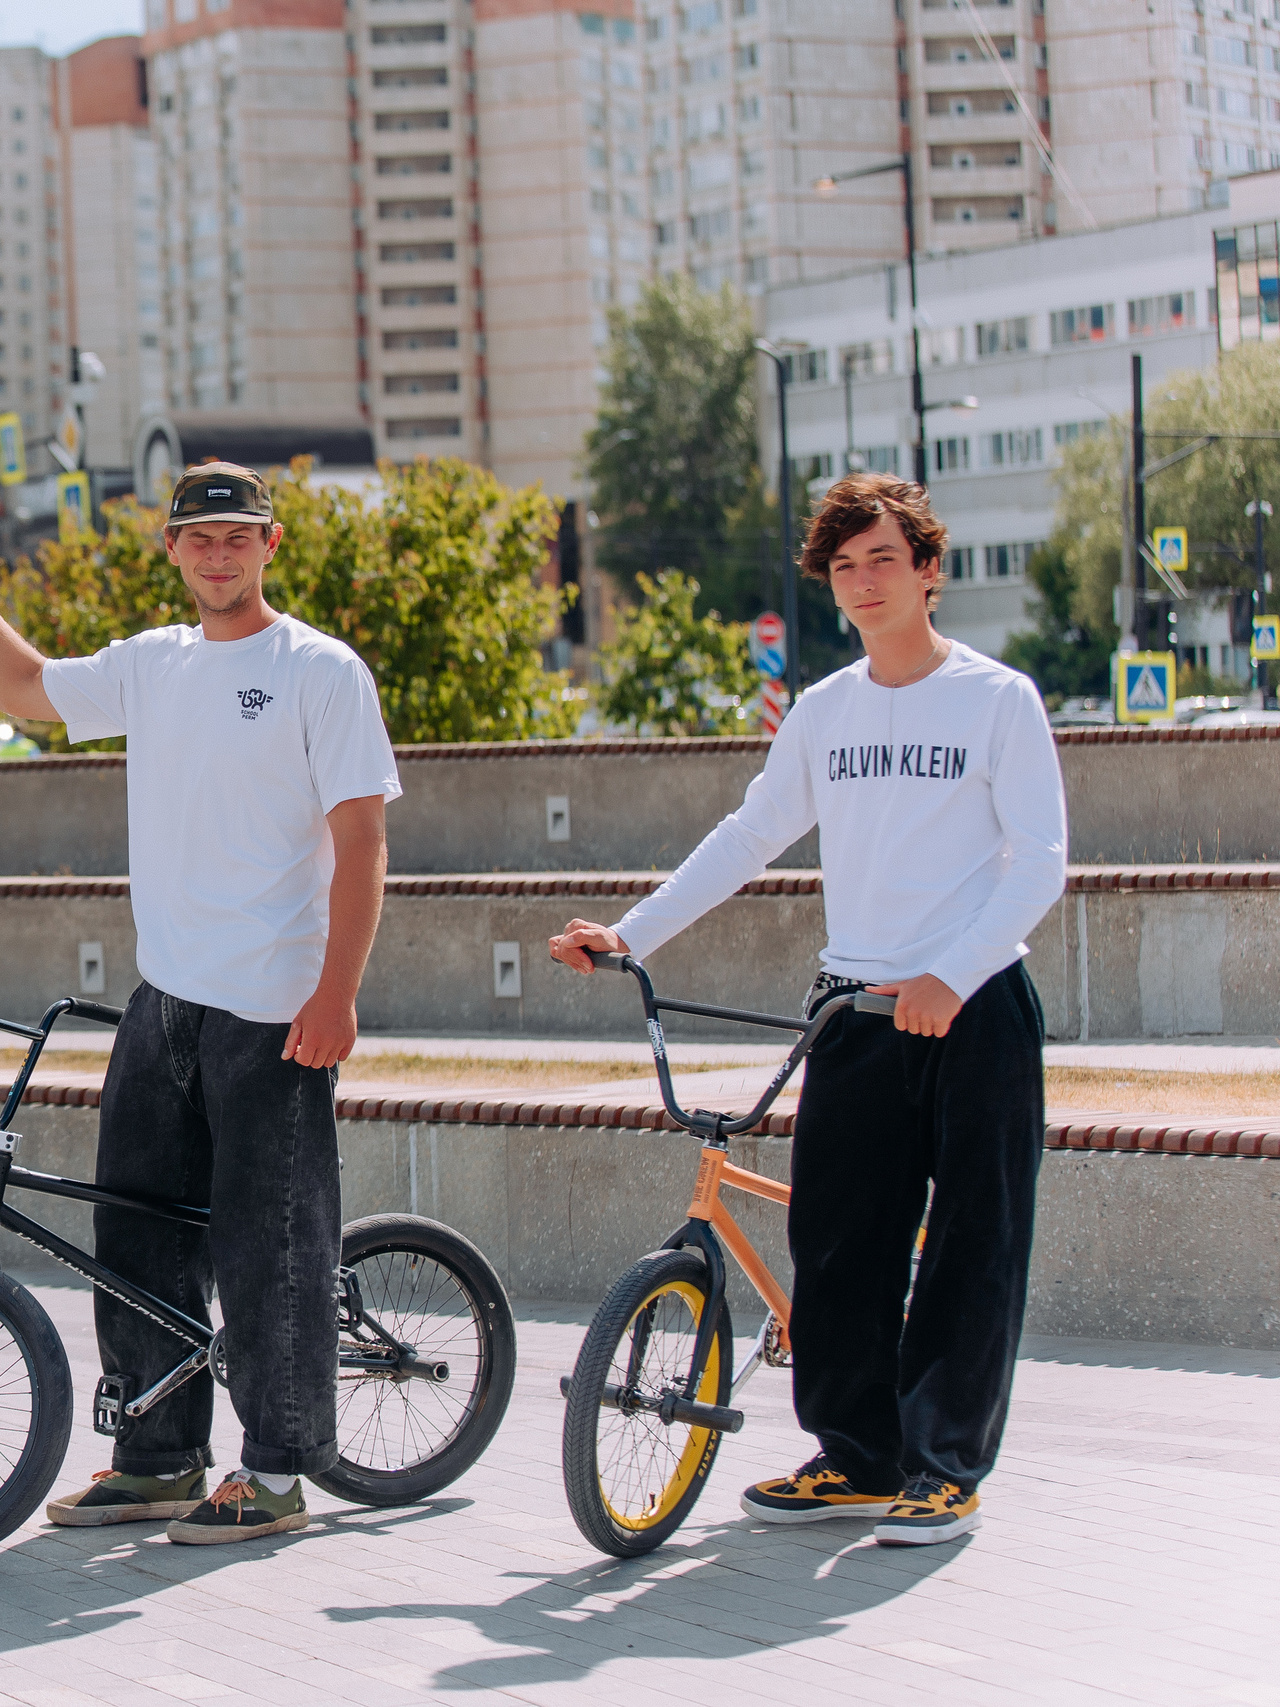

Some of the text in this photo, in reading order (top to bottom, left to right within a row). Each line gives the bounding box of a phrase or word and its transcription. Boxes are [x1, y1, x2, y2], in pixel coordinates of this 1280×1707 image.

[828, 744, 967, 782] CALVIN KLEIN
[697, 1429, 718, 1478] AXXIS
